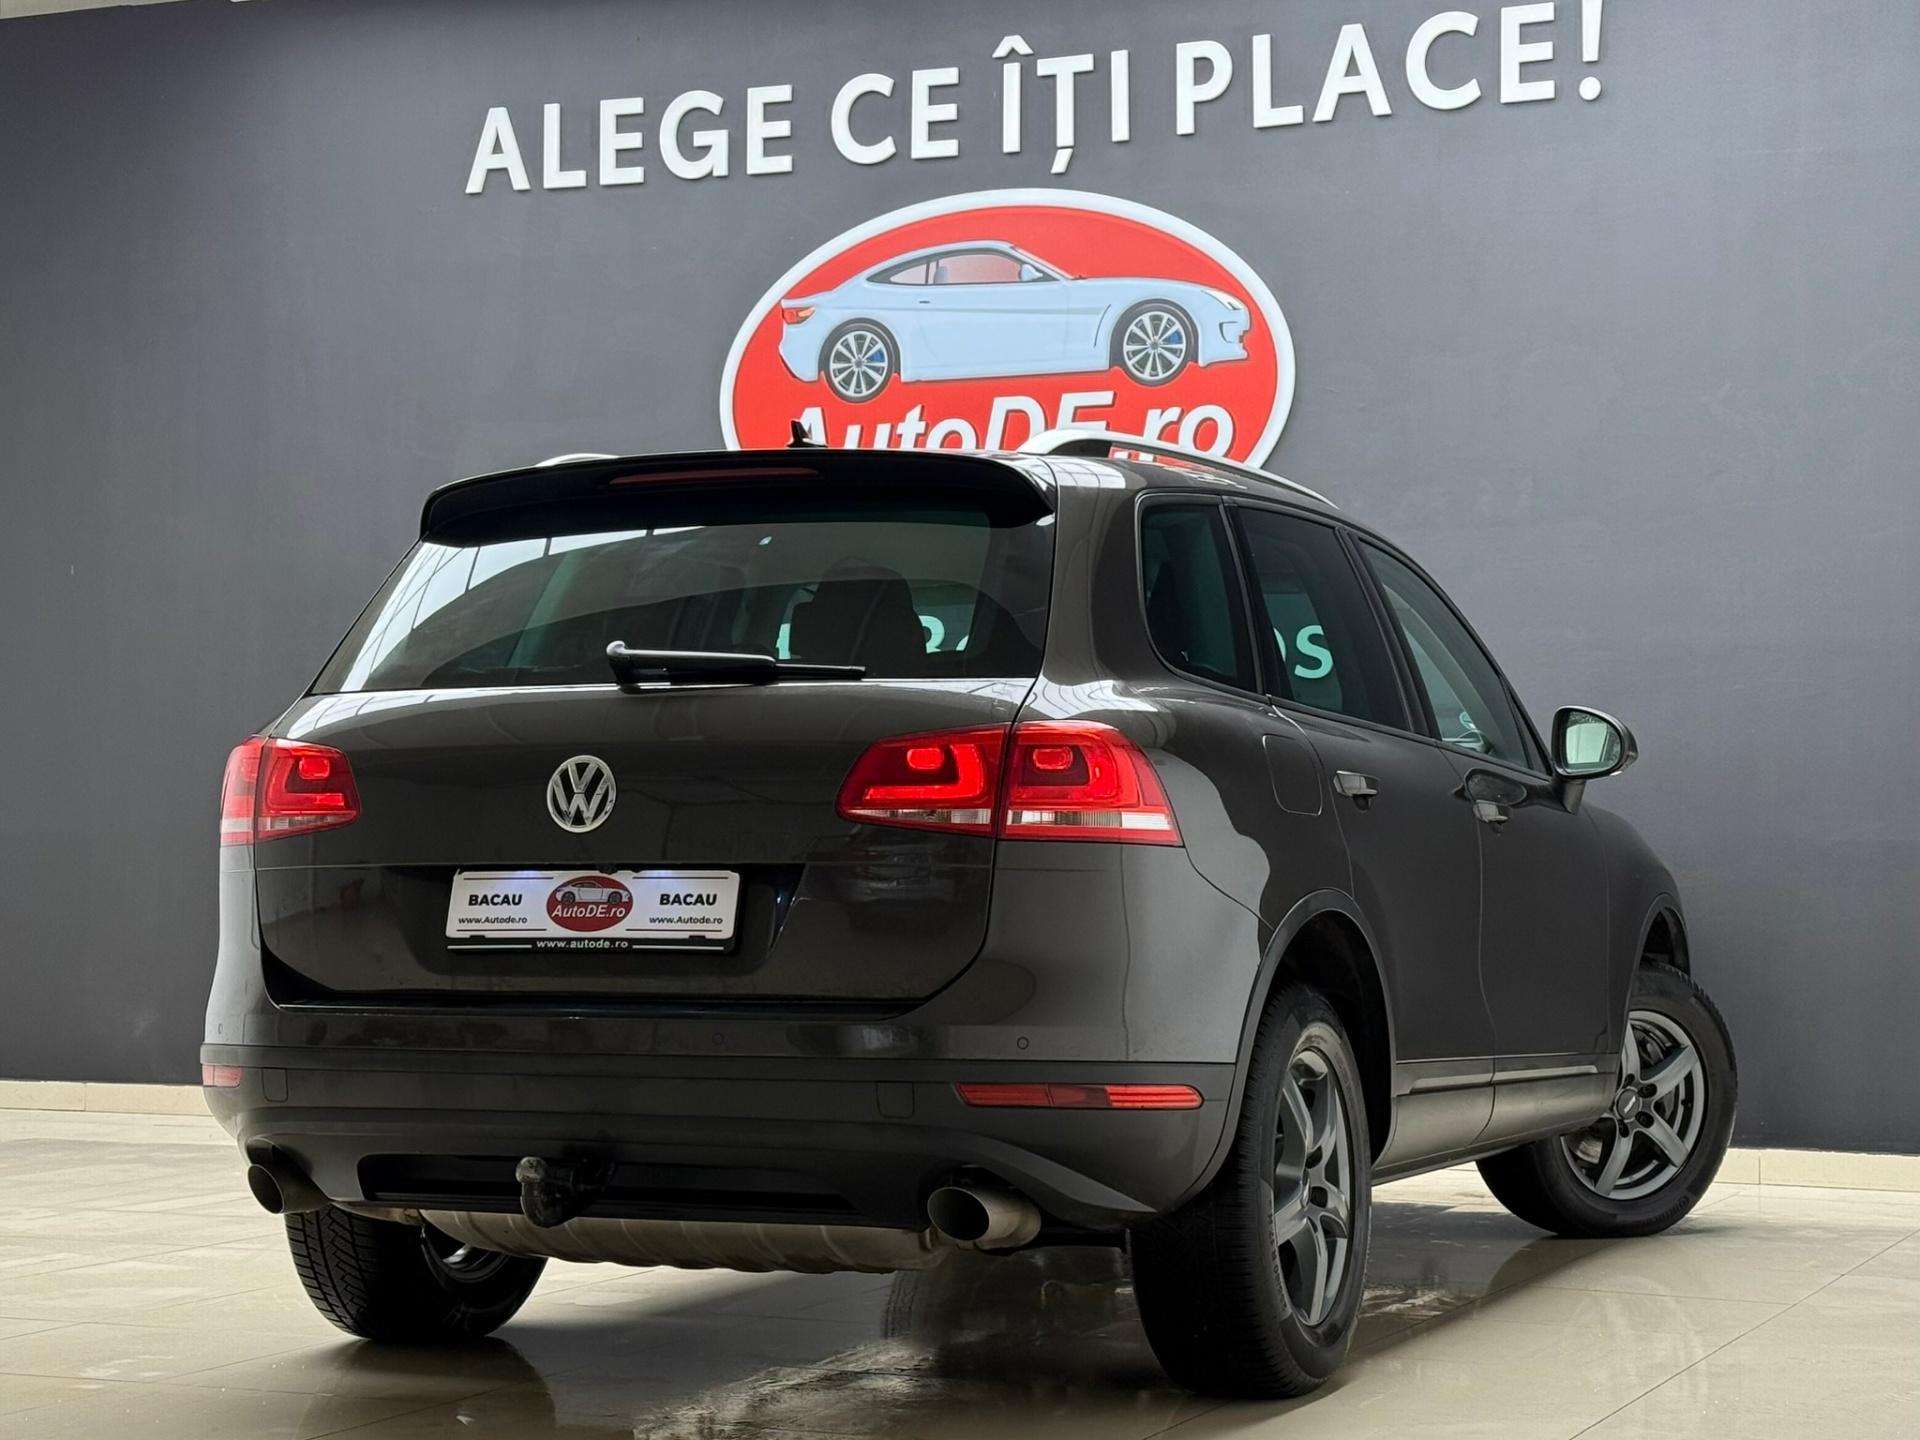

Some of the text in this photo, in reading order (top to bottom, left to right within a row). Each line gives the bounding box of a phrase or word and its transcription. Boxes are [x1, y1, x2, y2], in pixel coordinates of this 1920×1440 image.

[465, 0, 1602, 194] ALEGE CE ÎȚI PLACE!
[468, 894, 523, 906] BACAU
[659, 893, 718, 906] BACAU
[551, 904, 626, 919] AutoDE.ro
[458, 916, 528, 925] www.Autode.ro
[649, 916, 723, 925] www.Autode.ro
[536, 939, 629, 949] www.autode.ro
